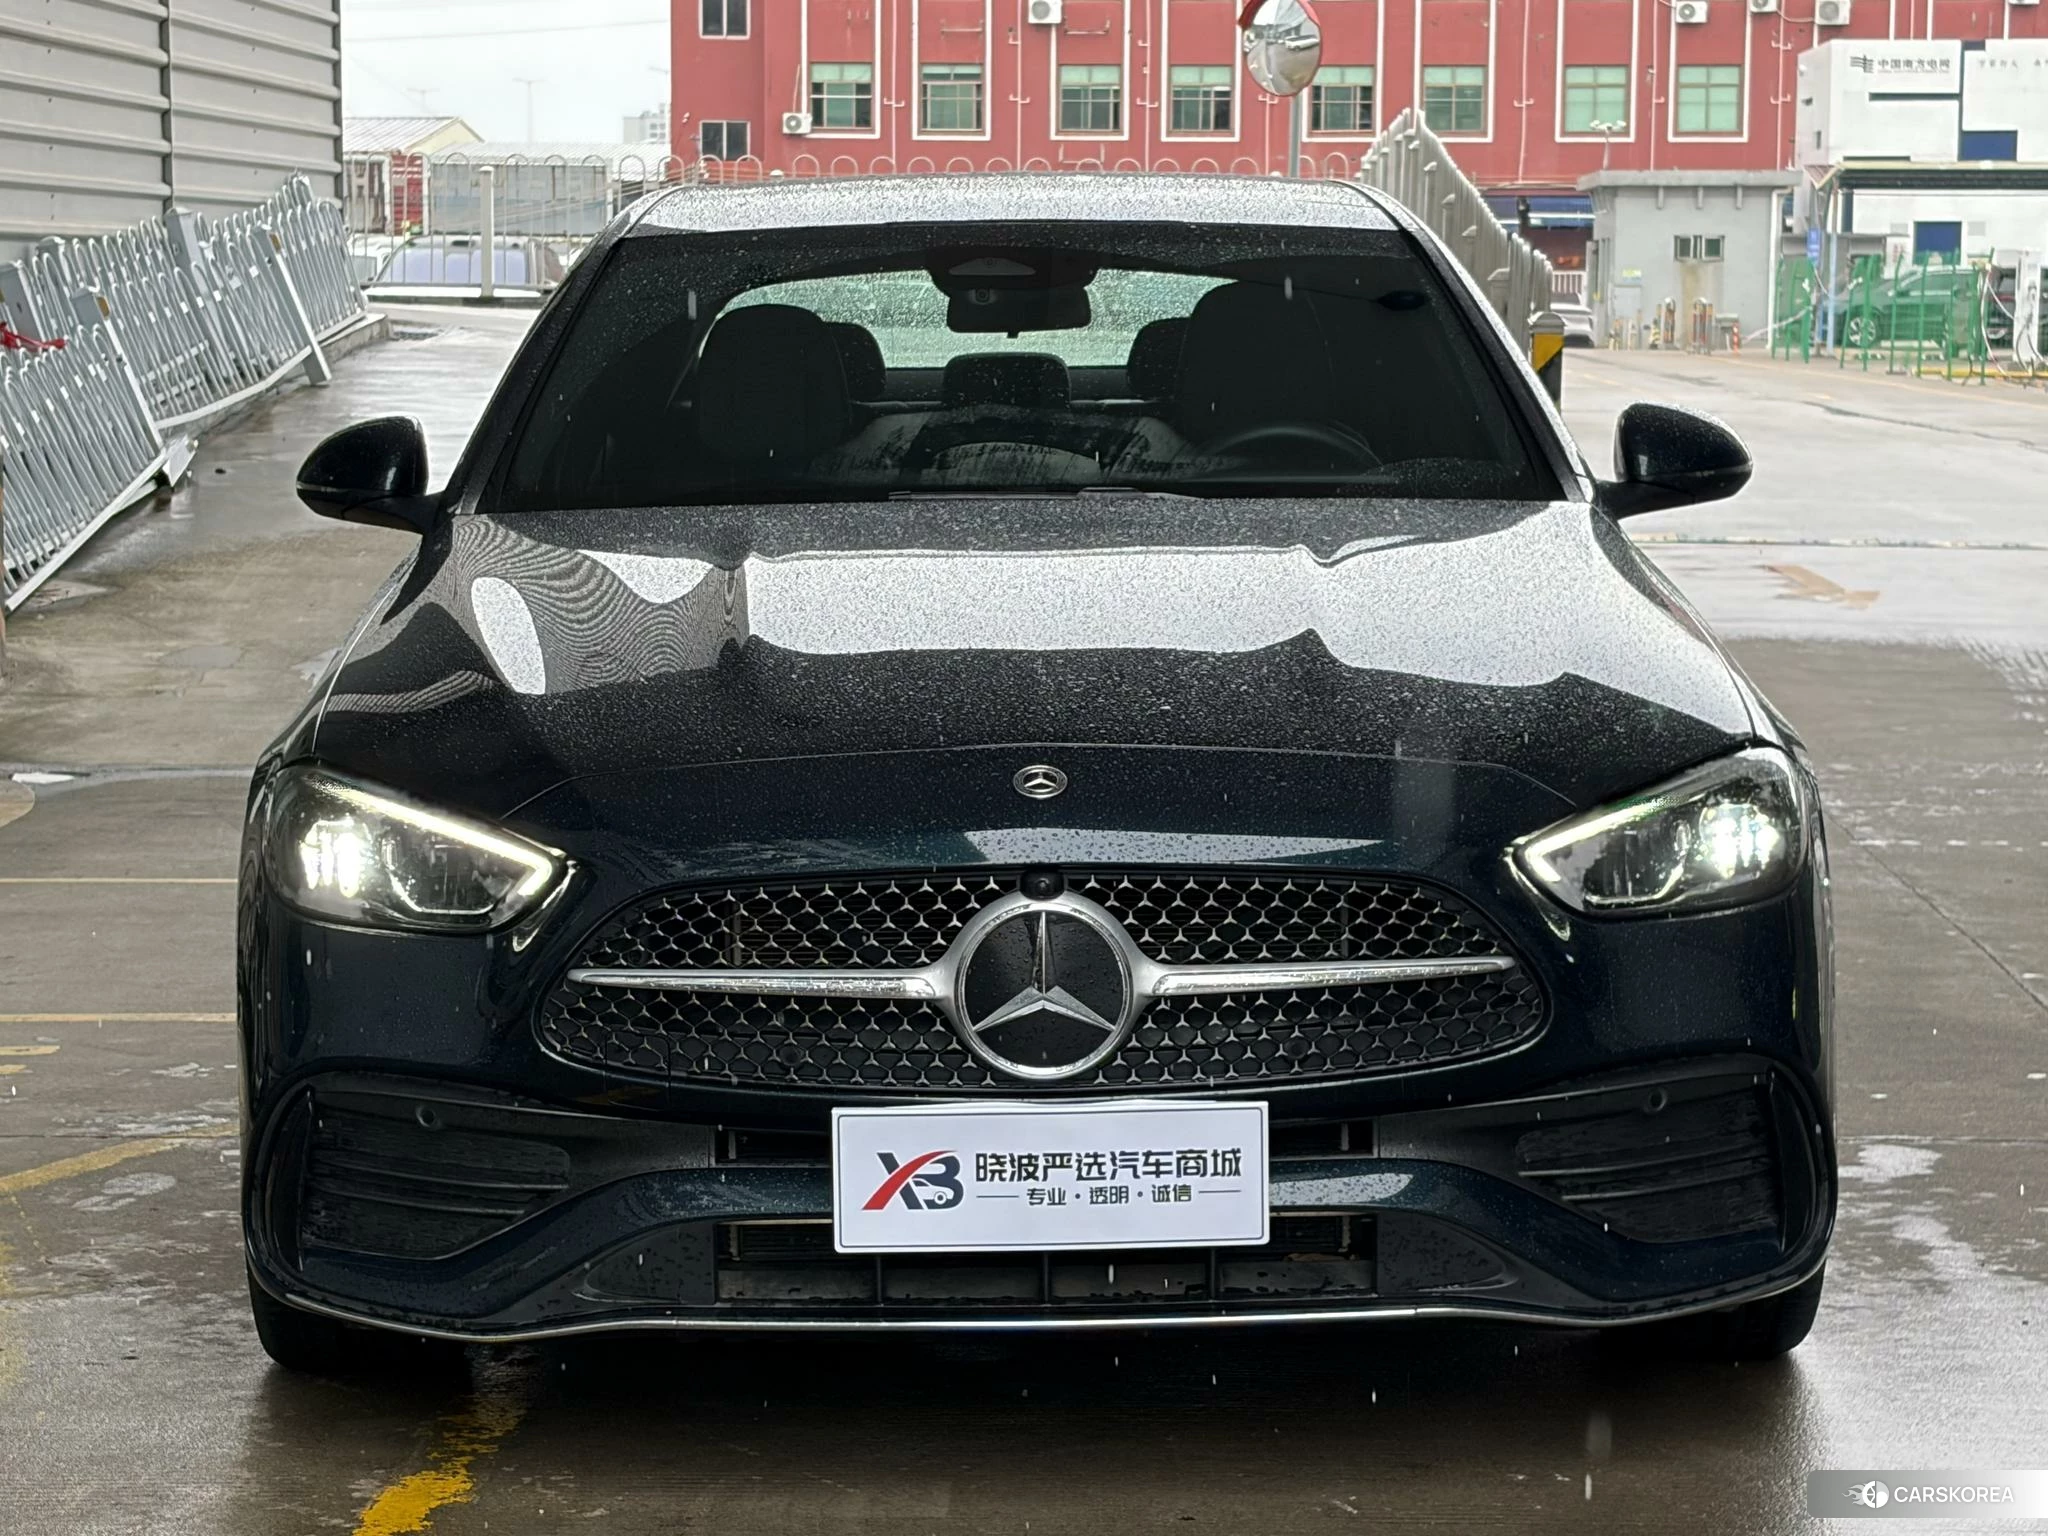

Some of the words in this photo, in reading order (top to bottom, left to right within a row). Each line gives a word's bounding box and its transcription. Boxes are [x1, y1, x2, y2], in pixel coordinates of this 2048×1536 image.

[975, 1148, 1242, 1182] 晓波严选汽车商城
